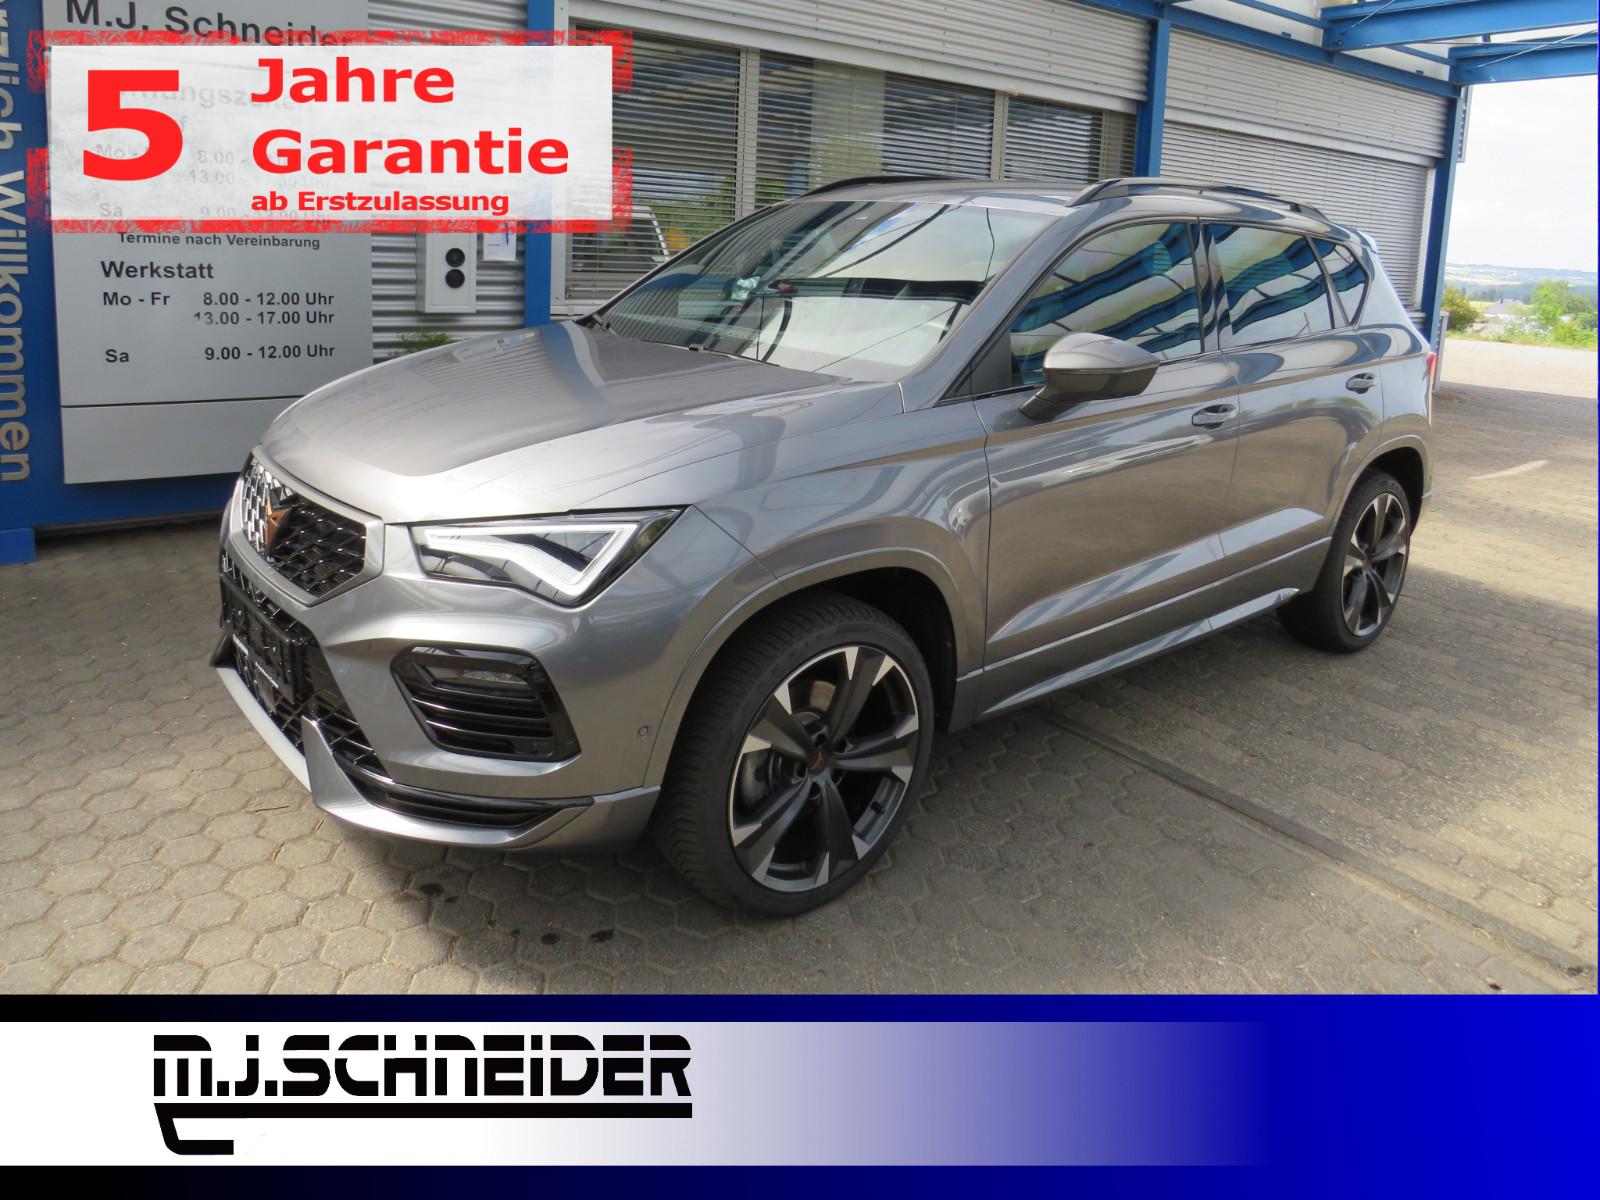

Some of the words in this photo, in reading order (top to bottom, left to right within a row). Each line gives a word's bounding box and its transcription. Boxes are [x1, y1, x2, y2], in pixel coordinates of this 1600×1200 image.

[66, 0, 149, 30] M.J.
[118, 231, 181, 245] Termine
[185, 234, 222, 247] nach
[226, 234, 320, 251] Vereinbarung
[100, 260, 215, 280] Werkstatt
[102, 291, 132, 307] Mo
[150, 291, 171, 307] Fr
[202, 291, 240, 306] 8.00
[256, 291, 301, 306] 12.00
[305, 291, 336, 306] Uhr
[0, 170, 31, 482] Willkommen
[193, 311, 241, 326] 13.00
[257, 310, 302, 325] 17.00
[306, 310, 336, 325] Uhr
[105, 348, 130, 364] Sa
[204, 346, 242, 361] 9.00
[258, 345, 302, 360] 12.00
[306, 343, 337, 358] Uhr
